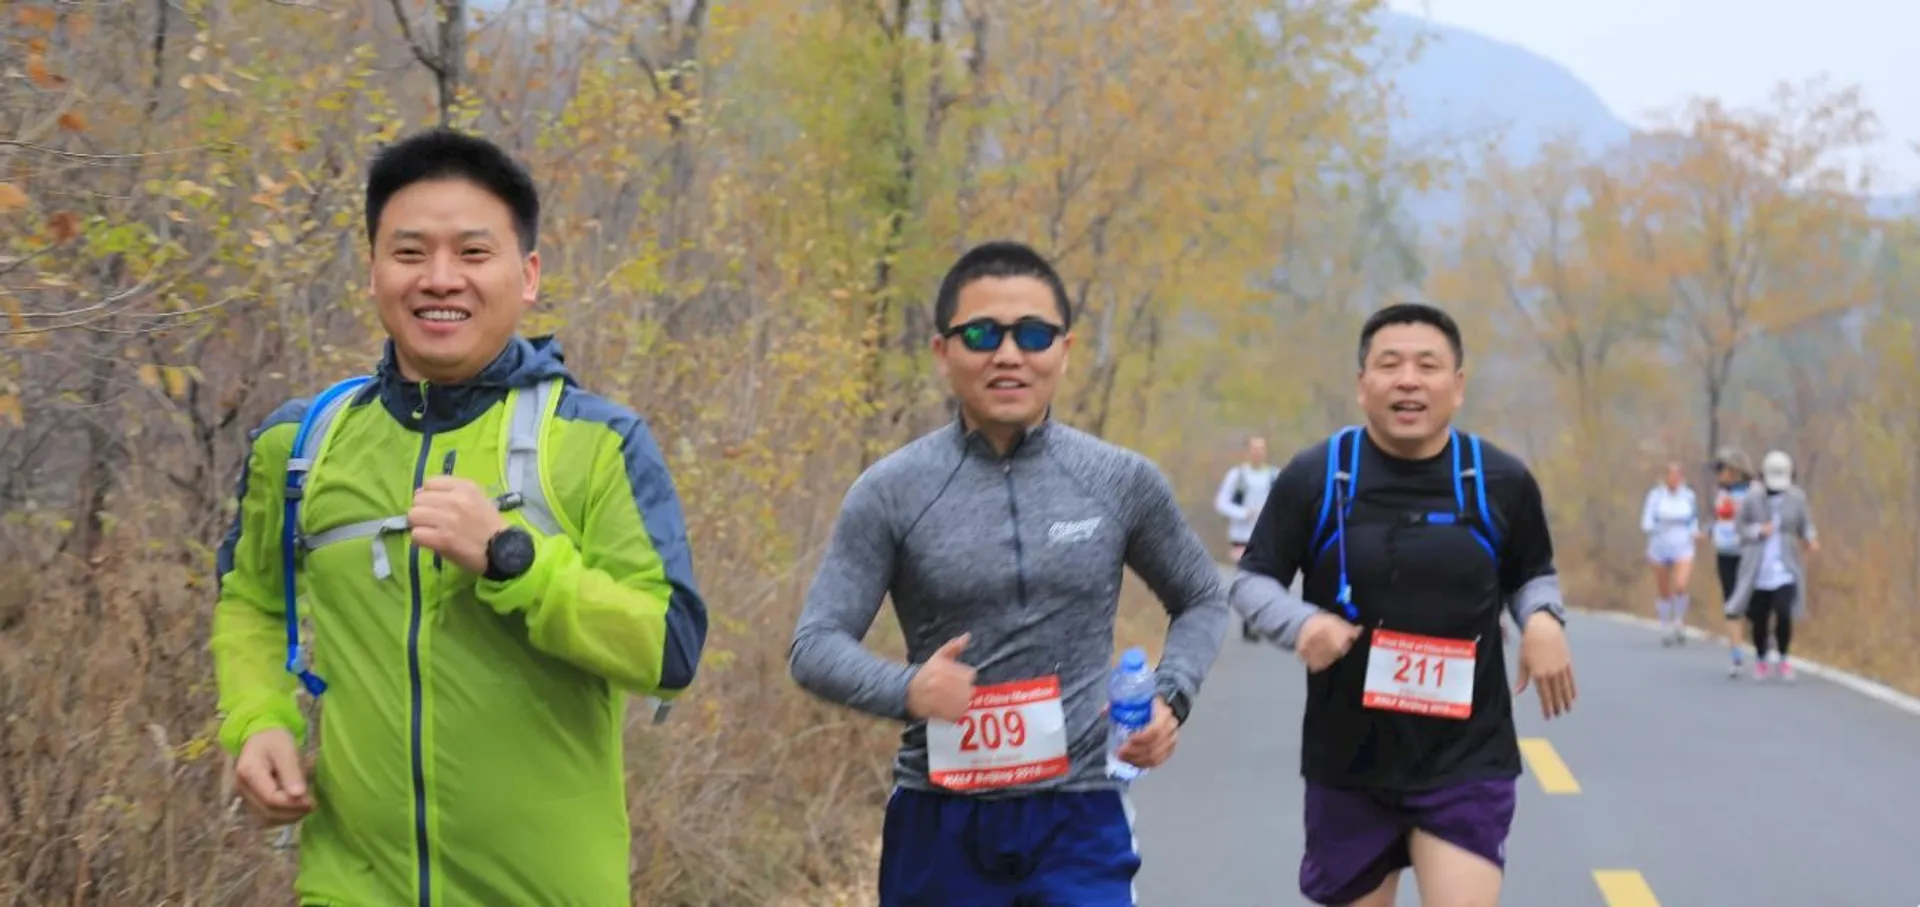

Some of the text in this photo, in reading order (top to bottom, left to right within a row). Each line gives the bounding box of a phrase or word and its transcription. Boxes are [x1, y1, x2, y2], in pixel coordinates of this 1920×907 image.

[1393, 652, 1445, 688] 211
[1010, 687, 1054, 702] Marathon
[956, 709, 1026, 752] 209
[974, 769, 1014, 785] Beijing
